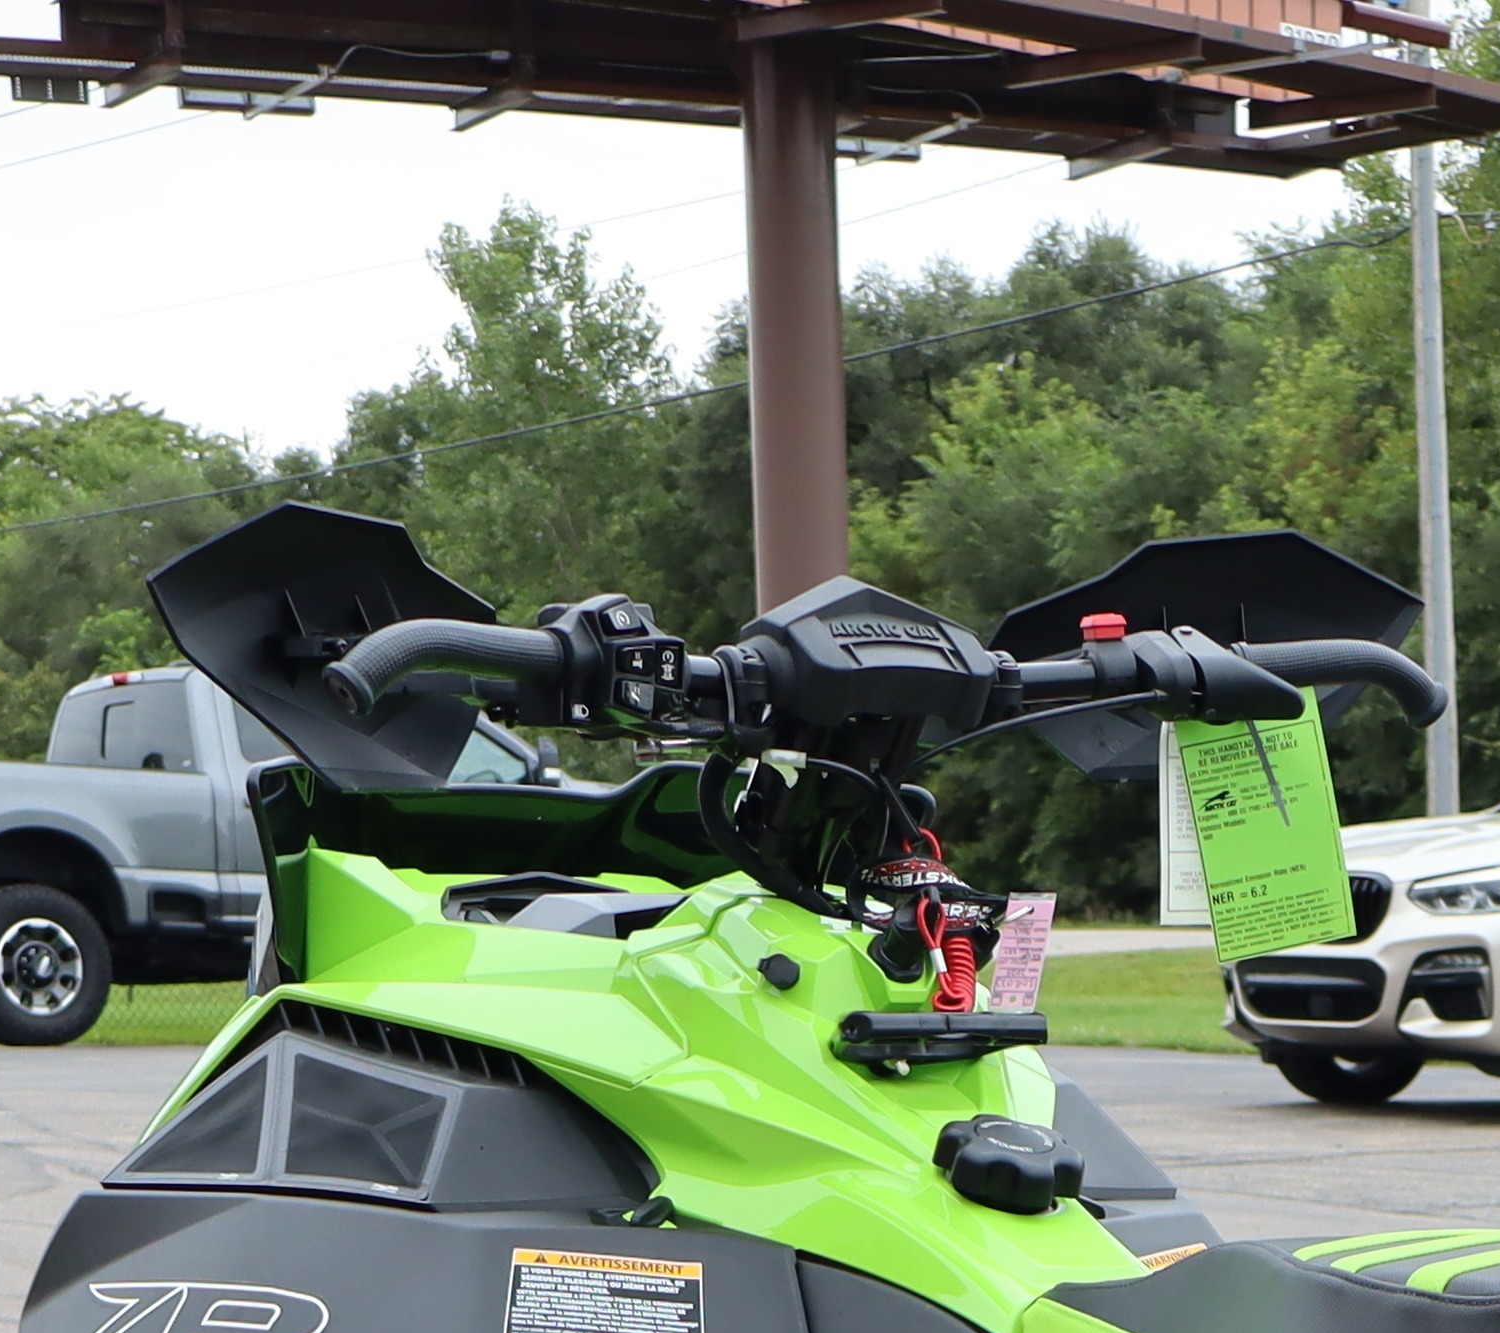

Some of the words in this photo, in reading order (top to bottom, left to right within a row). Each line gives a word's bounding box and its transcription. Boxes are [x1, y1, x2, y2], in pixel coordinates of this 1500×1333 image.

[829, 622, 902, 638] ARCTIC
[903, 625, 940, 641] CAT
[1211, 890, 1235, 906] NER
[1250, 884, 1267, 899] 6.2
[559, 1254, 684, 1275] AVERTISSEMENT
[1143, 1249, 1191, 1268] WARNING
